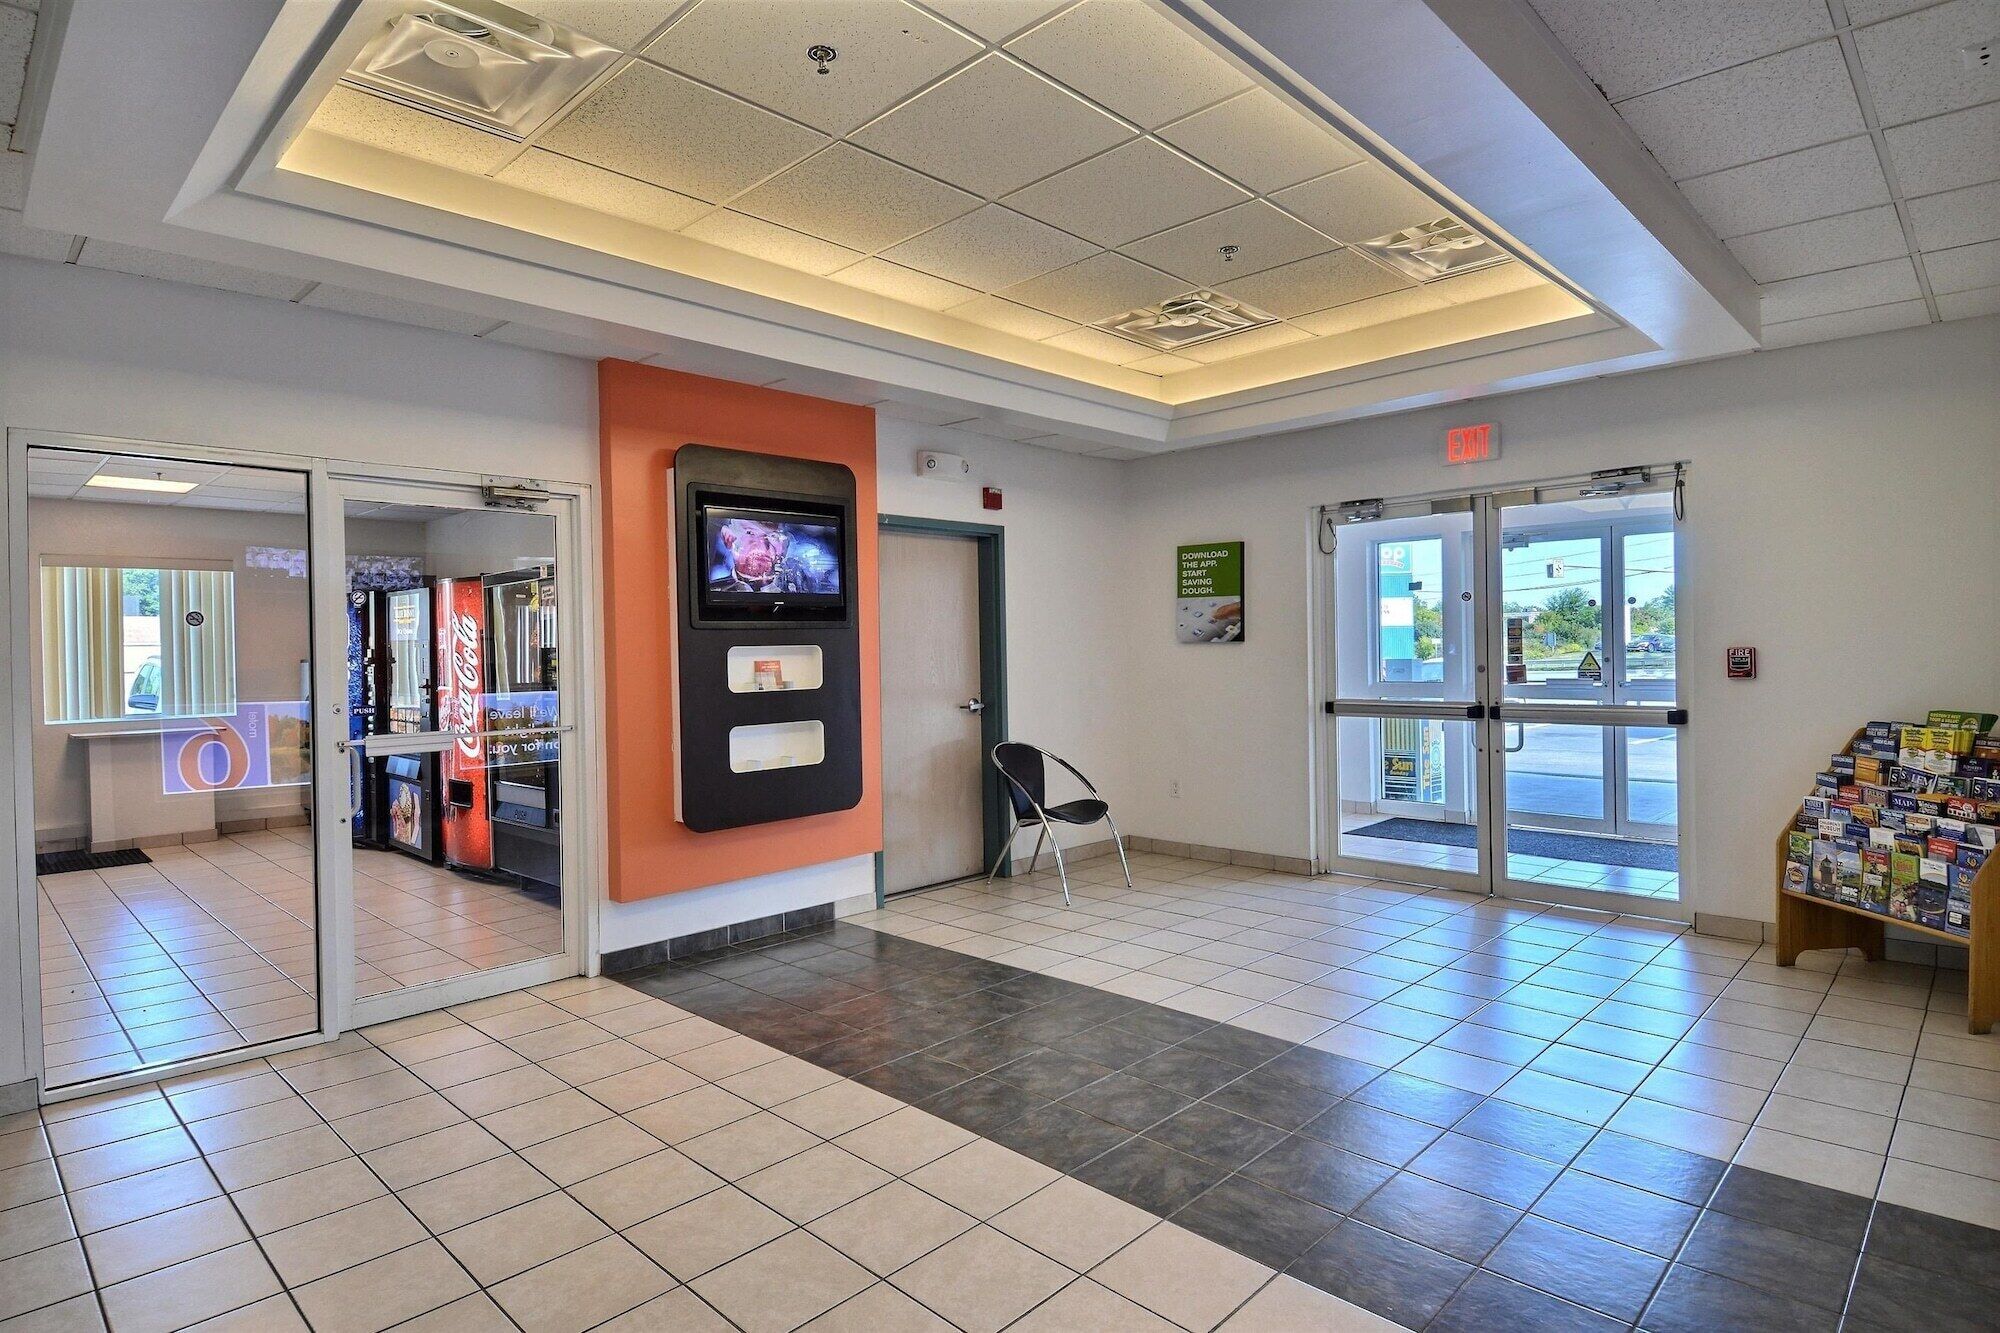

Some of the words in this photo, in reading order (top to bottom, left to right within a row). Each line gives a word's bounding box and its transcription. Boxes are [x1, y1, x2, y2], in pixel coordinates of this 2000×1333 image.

[1447, 424, 1490, 462] EXIT
[1182, 550, 1228, 560] DOWNLOAD
[1182, 561, 1198, 569] THE
[1200, 560, 1218, 568] APP.
[1182, 569, 1207, 578] START
[1182, 578, 1213, 586] SAVING
[1182, 587, 1215, 595] DOUGH.
[1729, 648, 1750, 656] FIRE
[353, 707, 375, 715] PUSH
[1392, 757, 1414, 772] Sun
